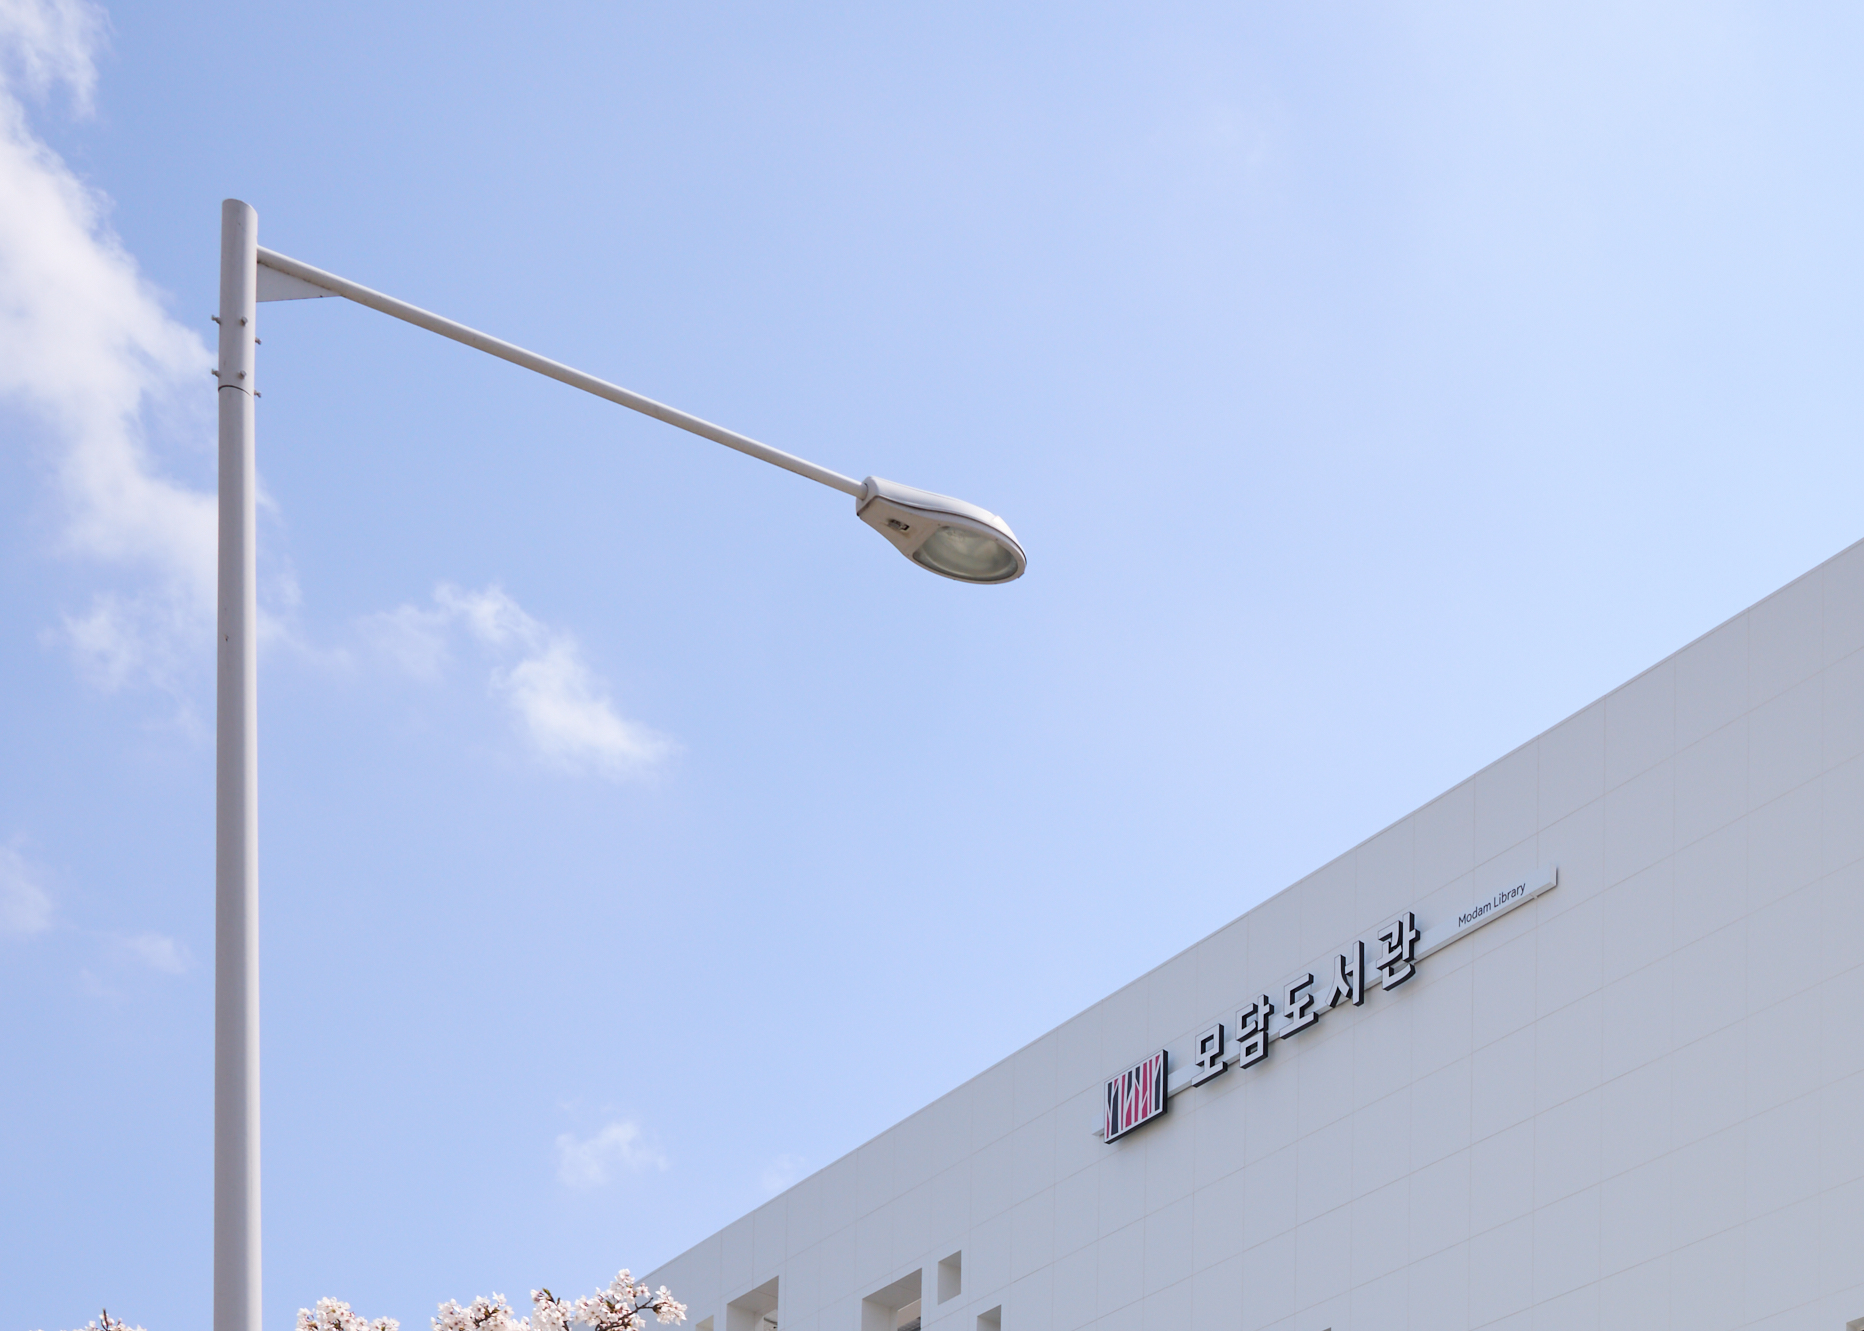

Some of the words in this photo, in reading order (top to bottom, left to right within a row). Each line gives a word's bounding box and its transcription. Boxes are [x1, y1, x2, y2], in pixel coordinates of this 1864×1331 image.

[1458, 901, 1491, 927] Modam
[1493, 883, 1526, 908] Library
[1191, 911, 1421, 1088] 모담도서관
